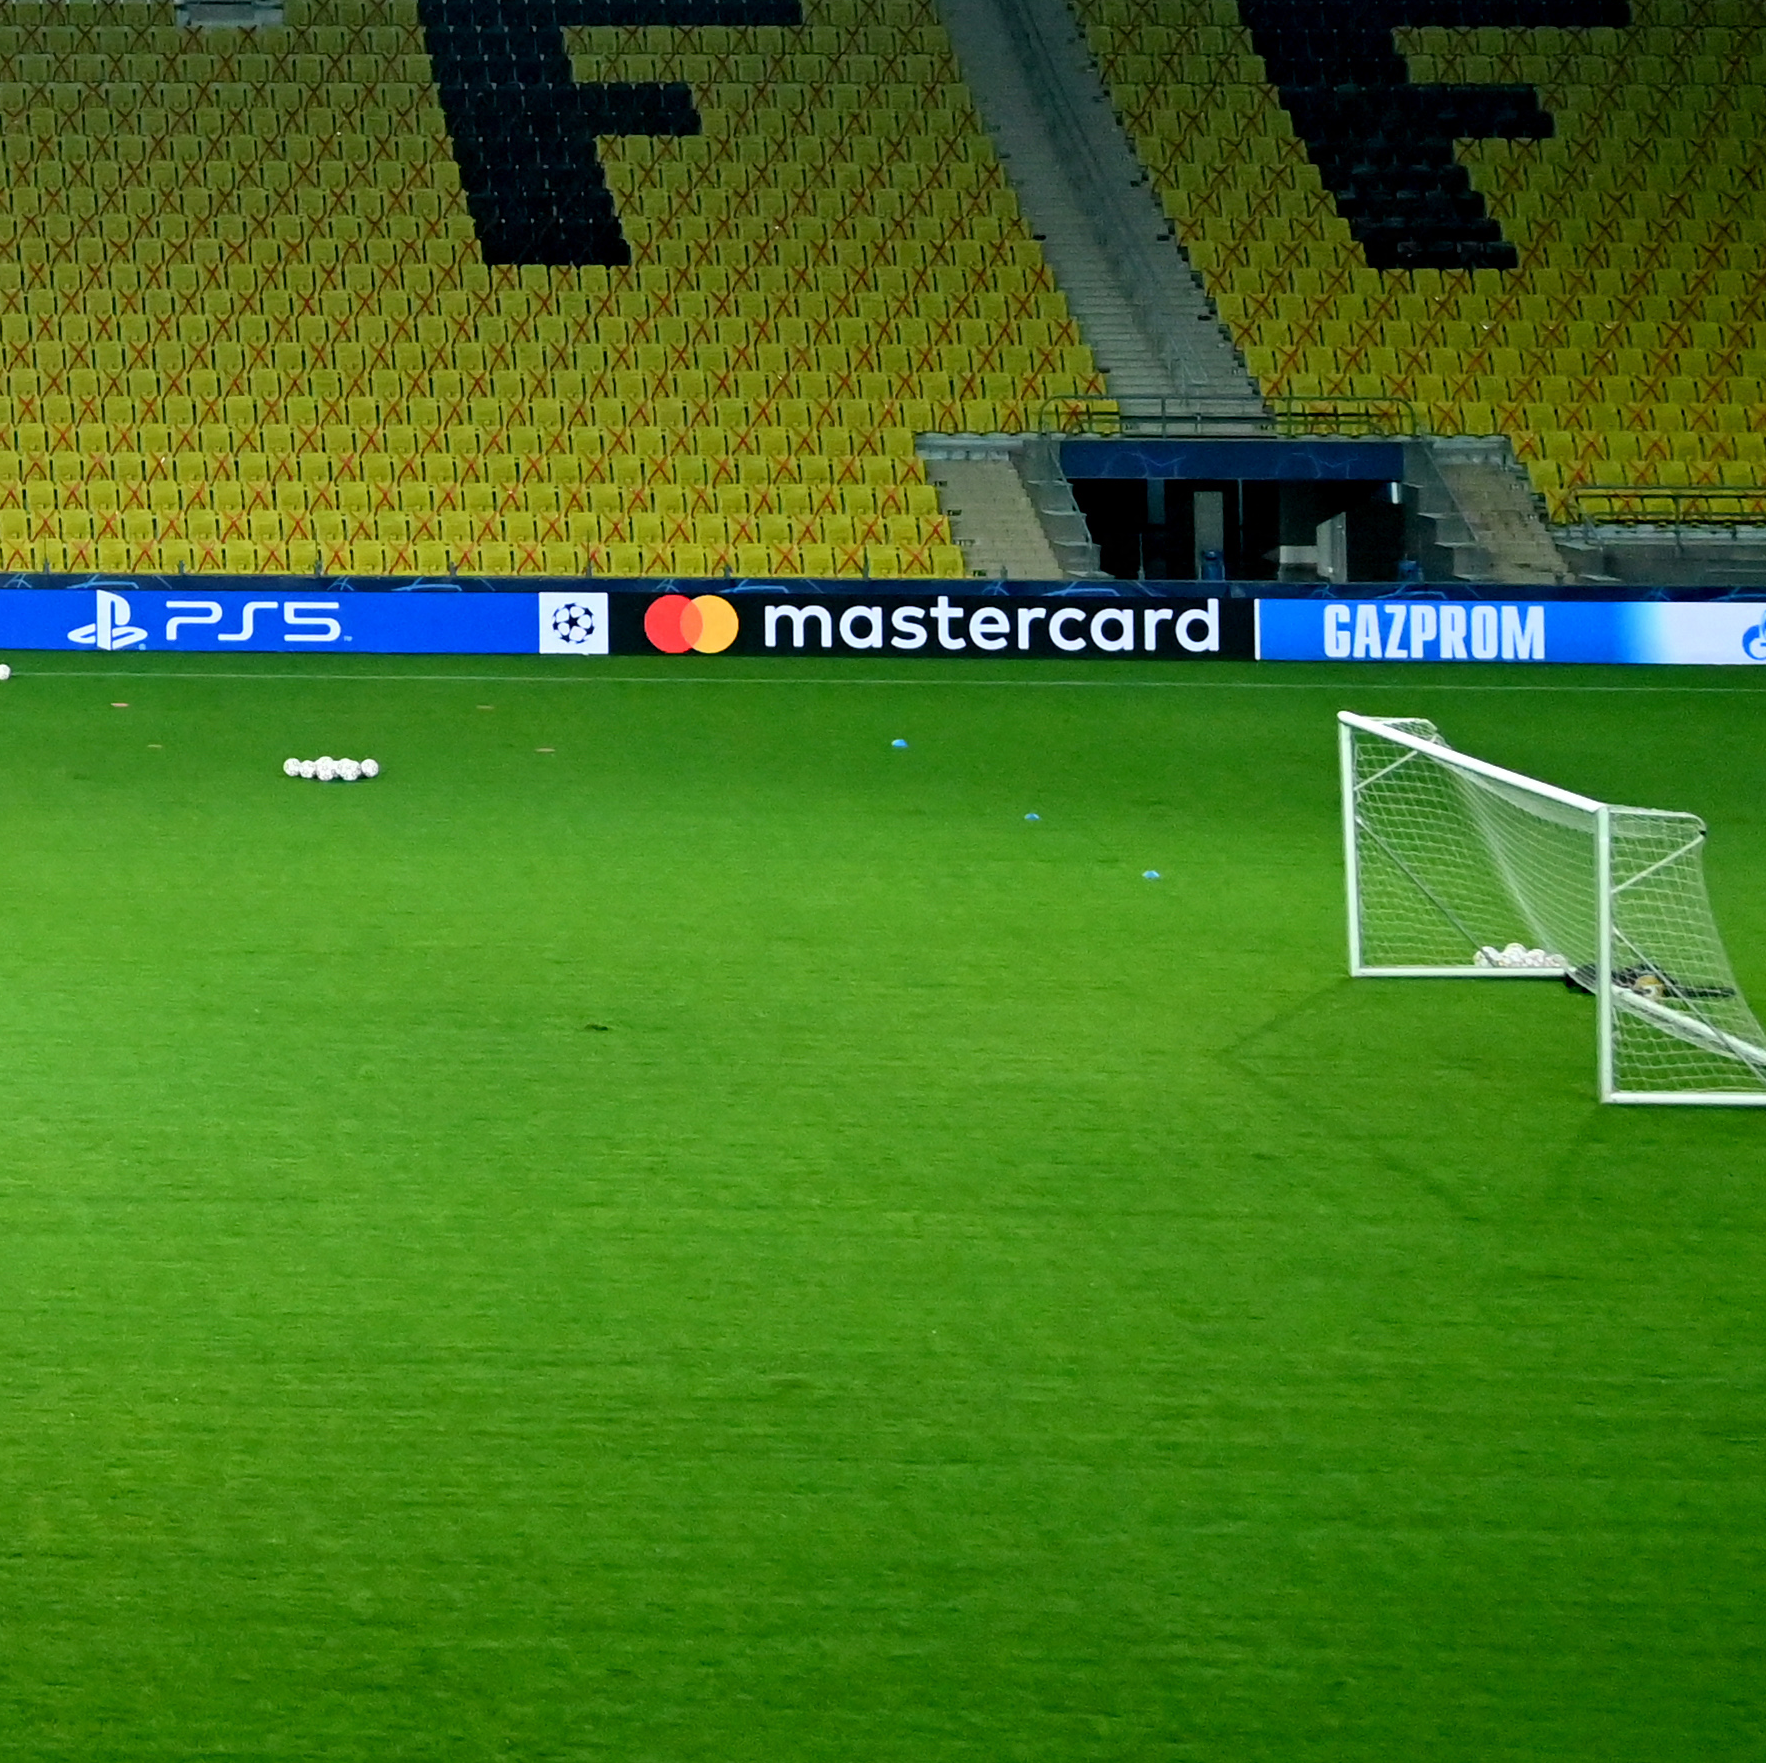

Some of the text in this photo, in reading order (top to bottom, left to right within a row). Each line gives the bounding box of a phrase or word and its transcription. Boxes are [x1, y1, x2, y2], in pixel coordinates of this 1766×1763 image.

[166, 601, 342, 642] PS5
[764, 595, 1220, 653] mastercard
[1323, 603, 1546, 660] GAZPROM
